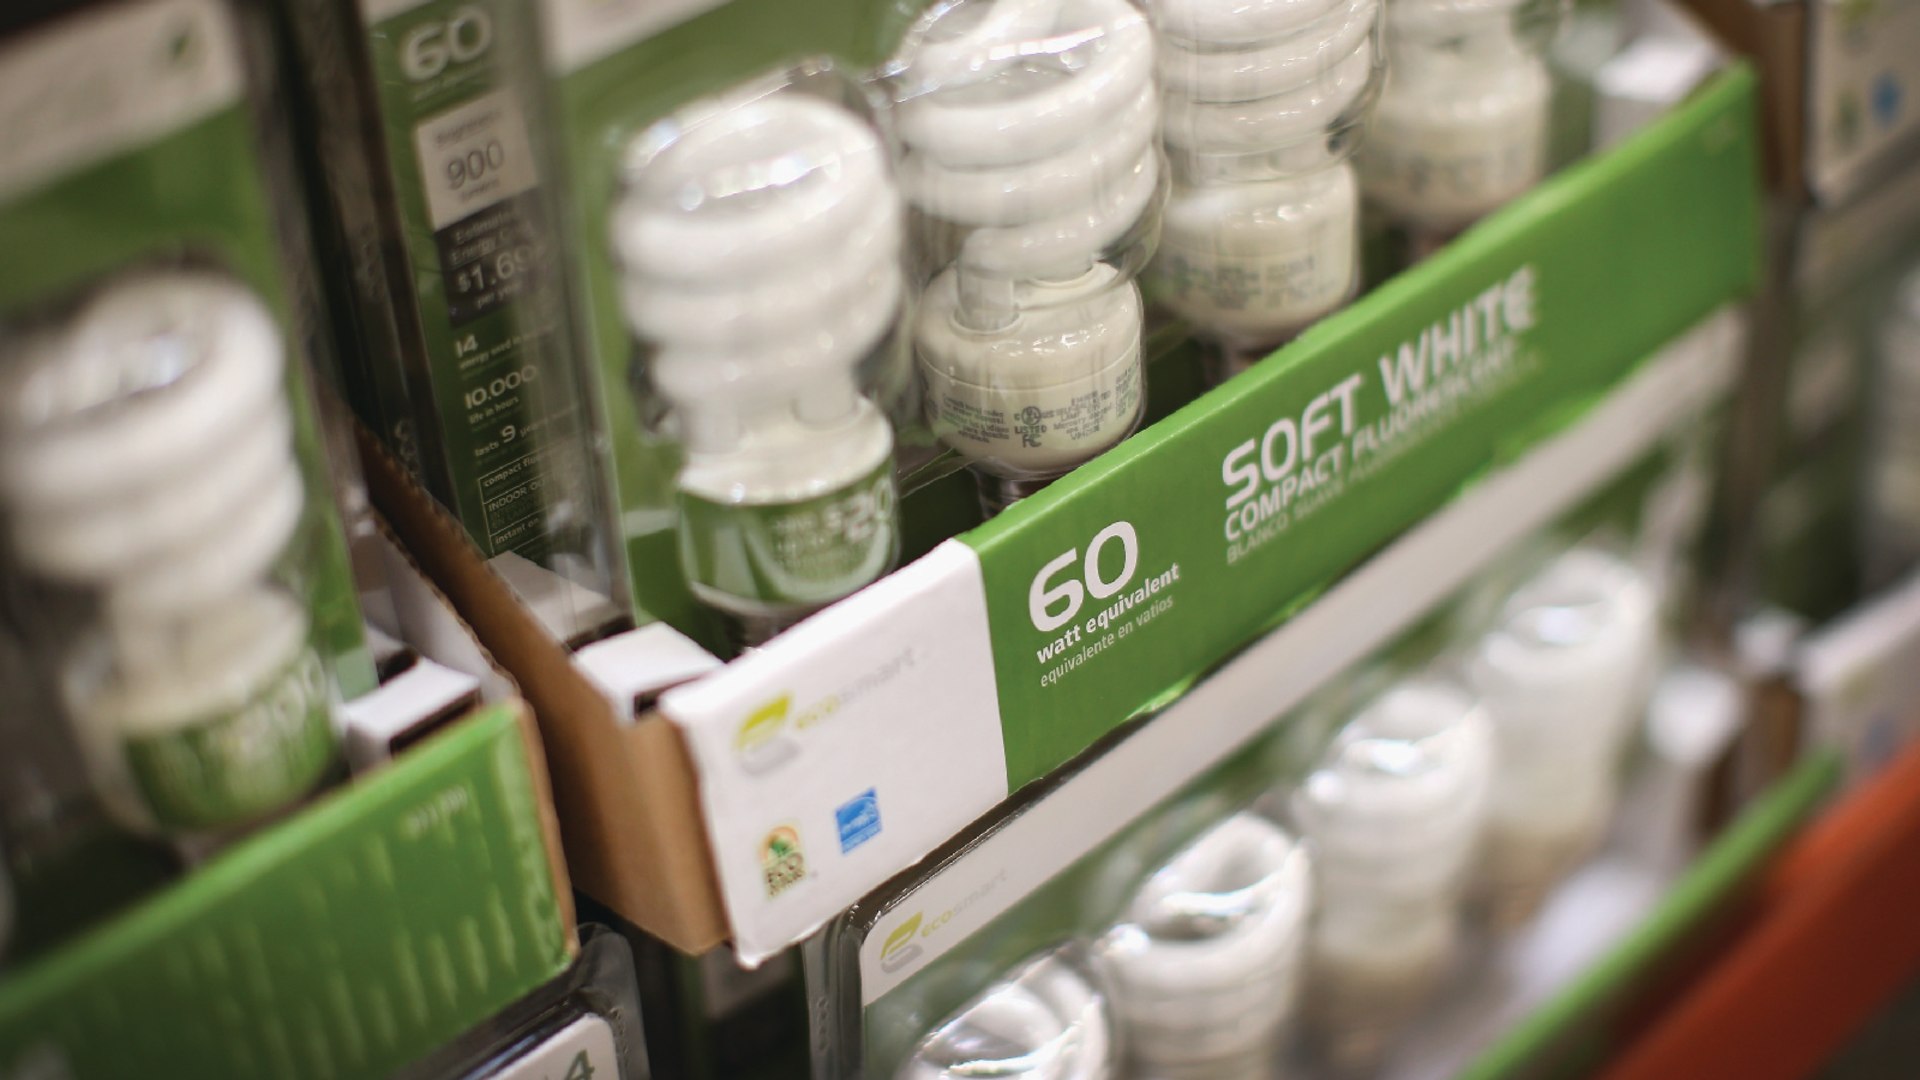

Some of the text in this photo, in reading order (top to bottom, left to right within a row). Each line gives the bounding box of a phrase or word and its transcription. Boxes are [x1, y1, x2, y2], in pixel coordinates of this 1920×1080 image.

[402, 6, 491, 80] 60
[447, 141, 503, 190] 900
[456, 333, 479, 358] 14
[1222, 372, 1364, 511] SOFT
[1378, 264, 1536, 406] WHITE
[502, 424, 516, 444] 9
[1014, 423, 1047, 434] LISTED
[483, 463, 521, 487] compact
[488, 486, 528, 512] INDOOR
[1225, 442, 1346, 543] COMPACT
[1226, 513, 1290, 565] BLANCO
[1029, 521, 1138, 632] 60
[1036, 562, 1180, 664] watt equivalent
[1040, 595, 1175, 687] equivalente en vatios
